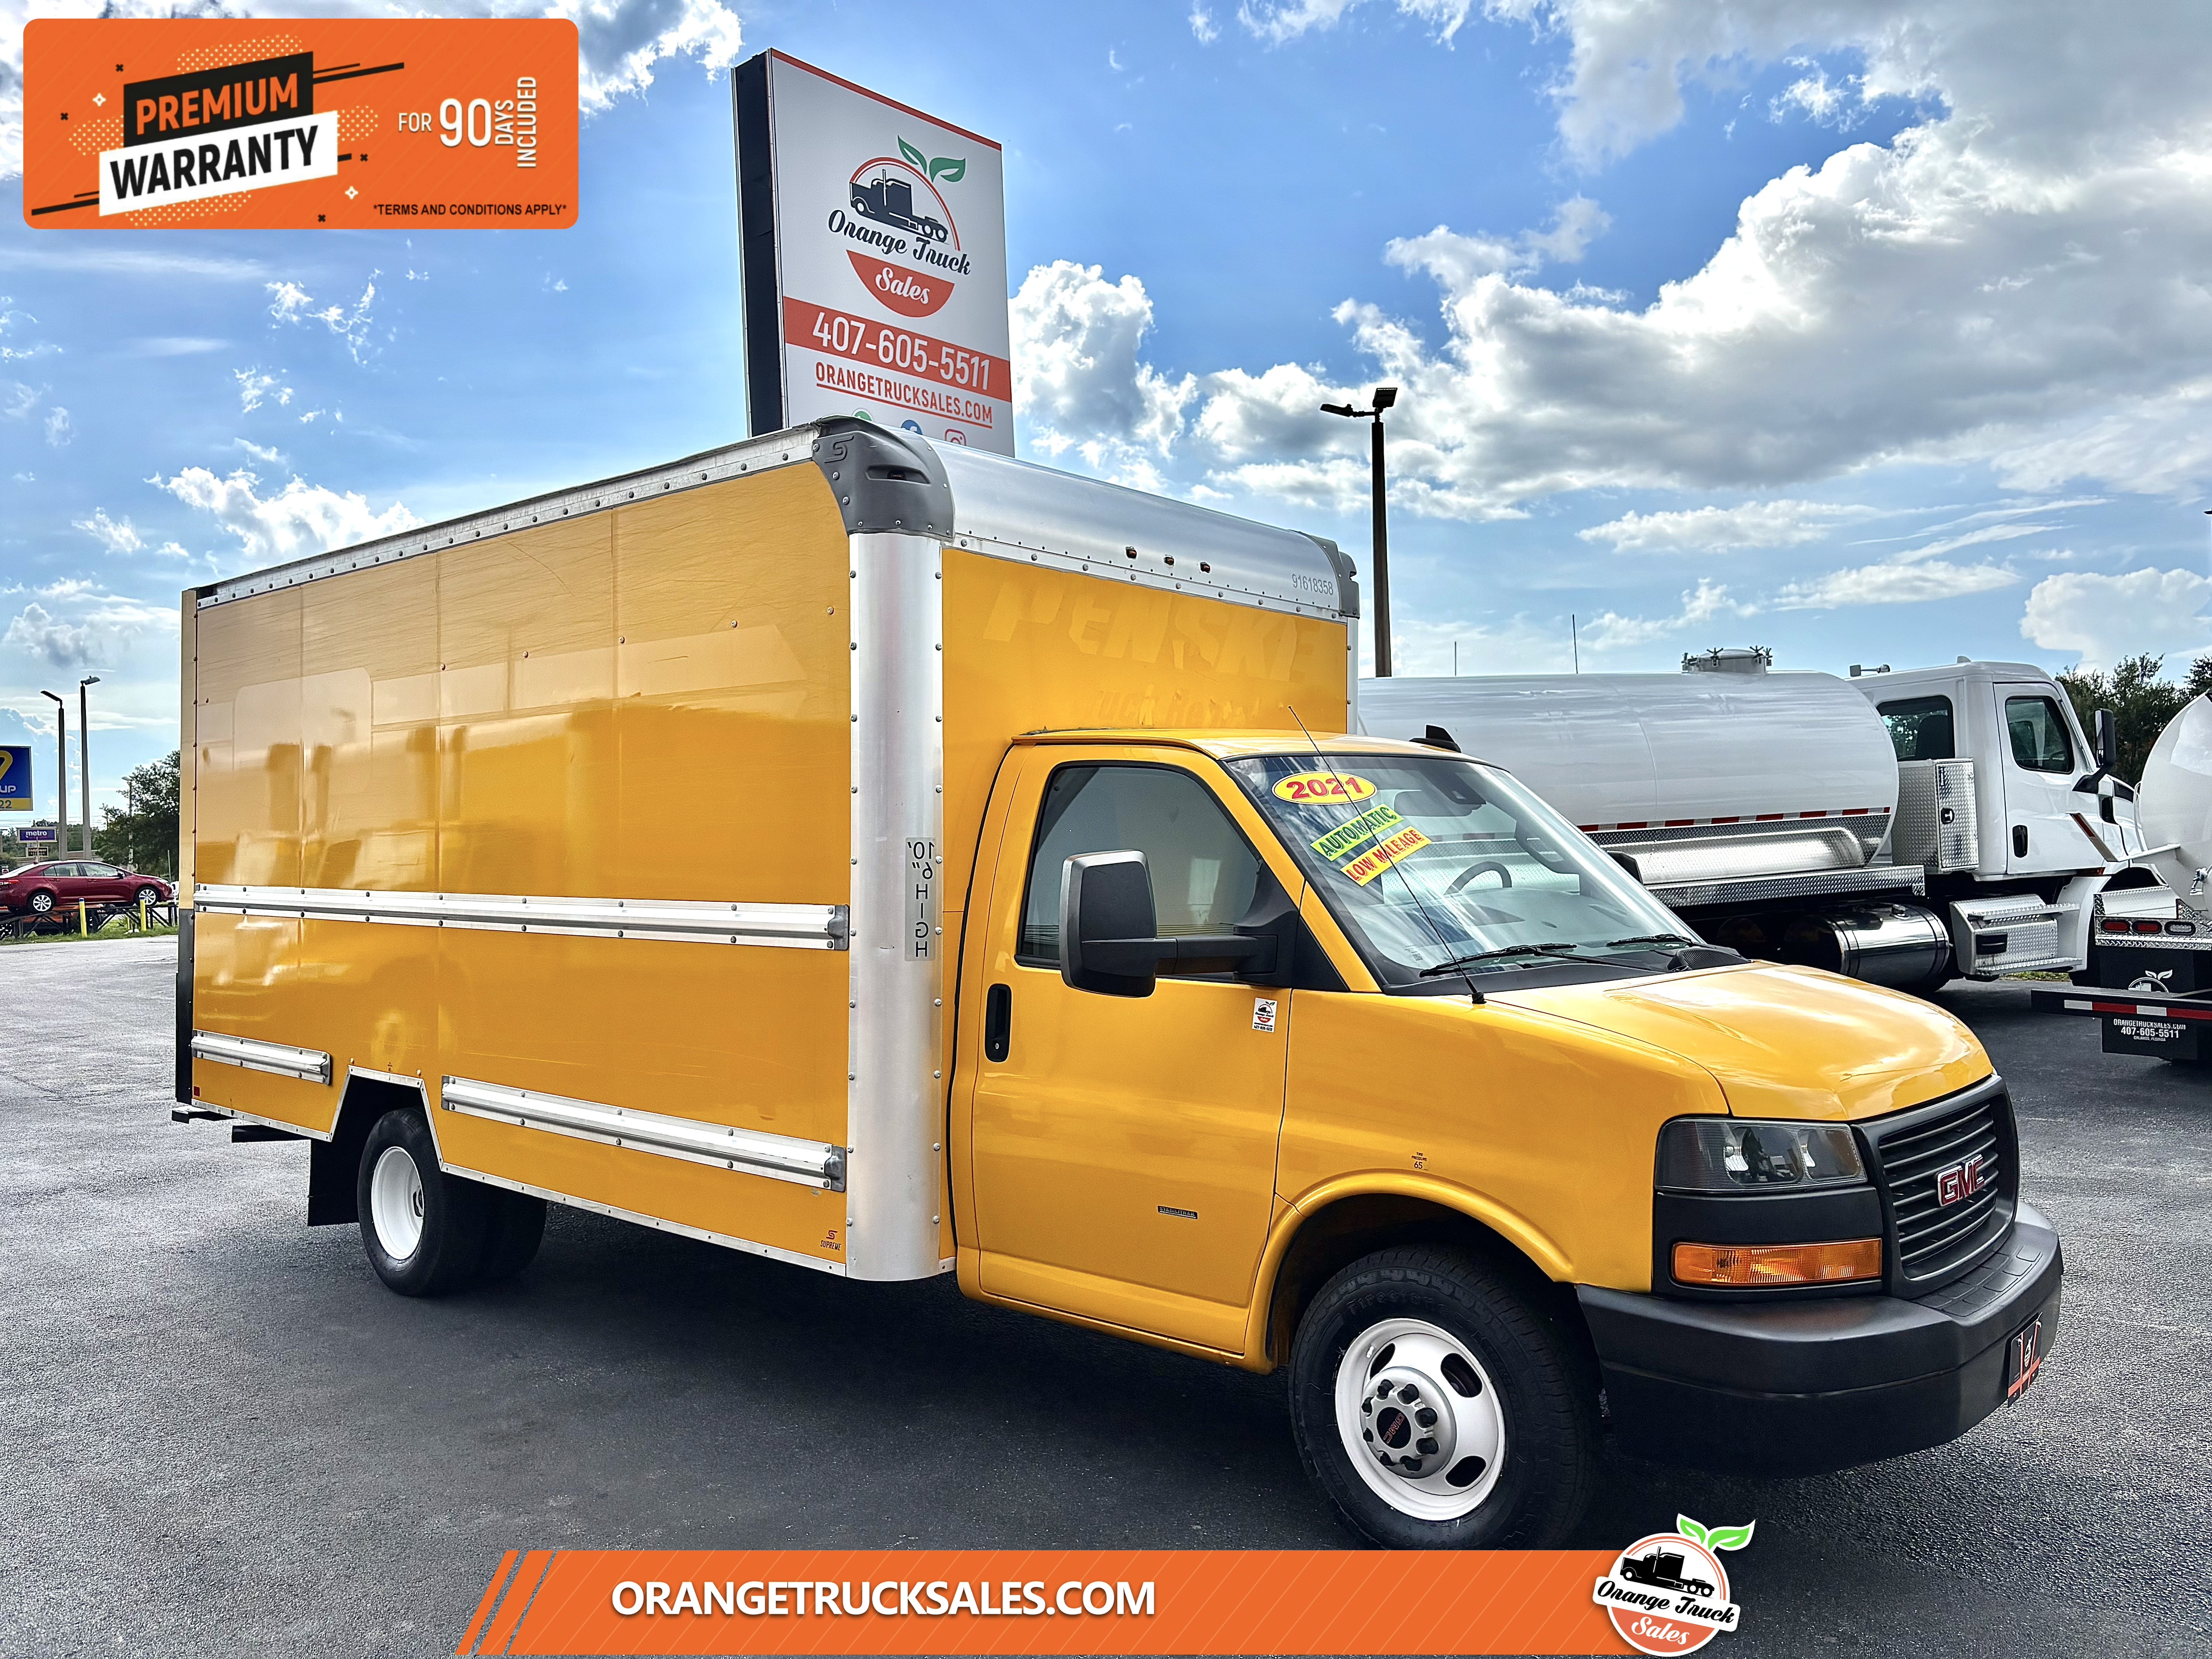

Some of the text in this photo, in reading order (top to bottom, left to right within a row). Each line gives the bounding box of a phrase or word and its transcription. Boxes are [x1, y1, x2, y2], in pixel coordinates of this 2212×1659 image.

[828, 210, 971, 275] Orange Truck
[875, 266, 930, 304] Sales
[812, 312, 990, 391] 407-605-5511
[815, 361, 993, 423] ORANGETRUCKSALES.COM
[1292, 573, 1334, 596] 91618358
[1286, 776, 1365, 800] 2021
[1319, 806, 1397, 857] AUTOMATIC
[1346, 828, 1424, 882] LOW MILEAGE
[2121, 1027, 2179, 1038] 407-605-5511
[1414, 1161, 1423, 1169] 65
[1937, 1154, 1985, 1207] GMC
[1159, 1207, 1195, 1216] STABILITRAK
[820, 1240, 842, 1251] SUPREME
[1382, 1412, 1405, 1444] GMC
